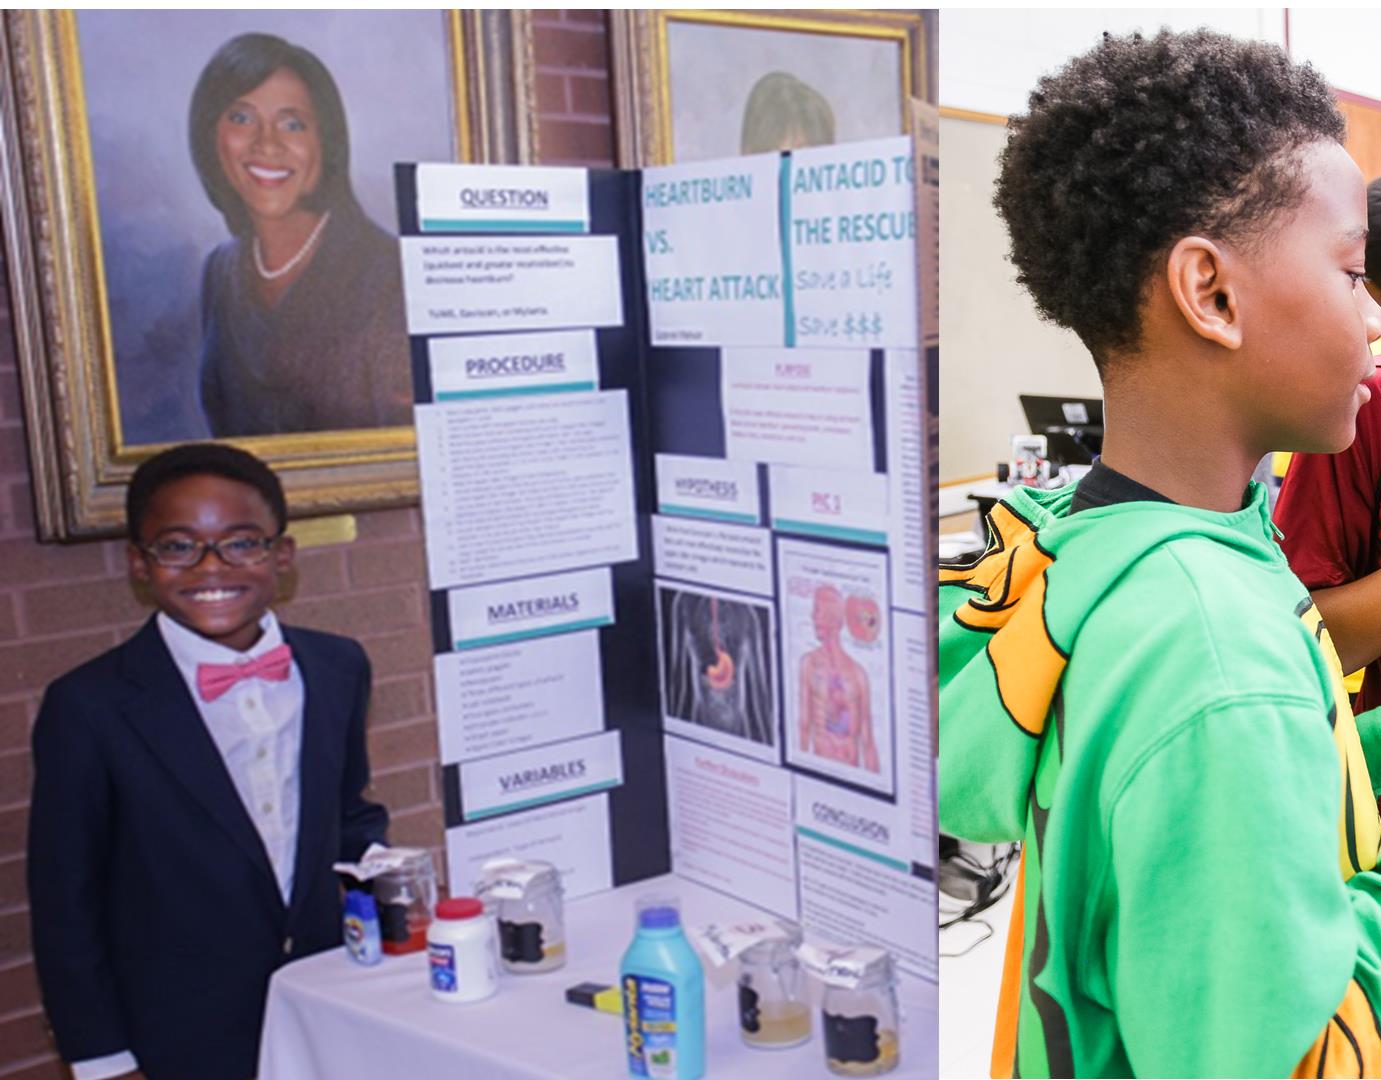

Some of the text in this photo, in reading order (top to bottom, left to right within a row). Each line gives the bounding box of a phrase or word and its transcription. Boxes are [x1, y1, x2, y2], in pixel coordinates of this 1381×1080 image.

[646, 174, 752, 207] HEARTBURN
[794, 160, 886, 193] ANTACID
[460, 188, 549, 208] QUESTION
[646, 229, 673, 254] VS.
[794, 212, 918, 245] THE RESCUE
[651, 274, 781, 302] HEART ATTACK
[465, 352, 566, 377] PROCEDURE
[487, 592, 580, 622] MATERIALS
[499, 759, 586, 792] VARIABLES
